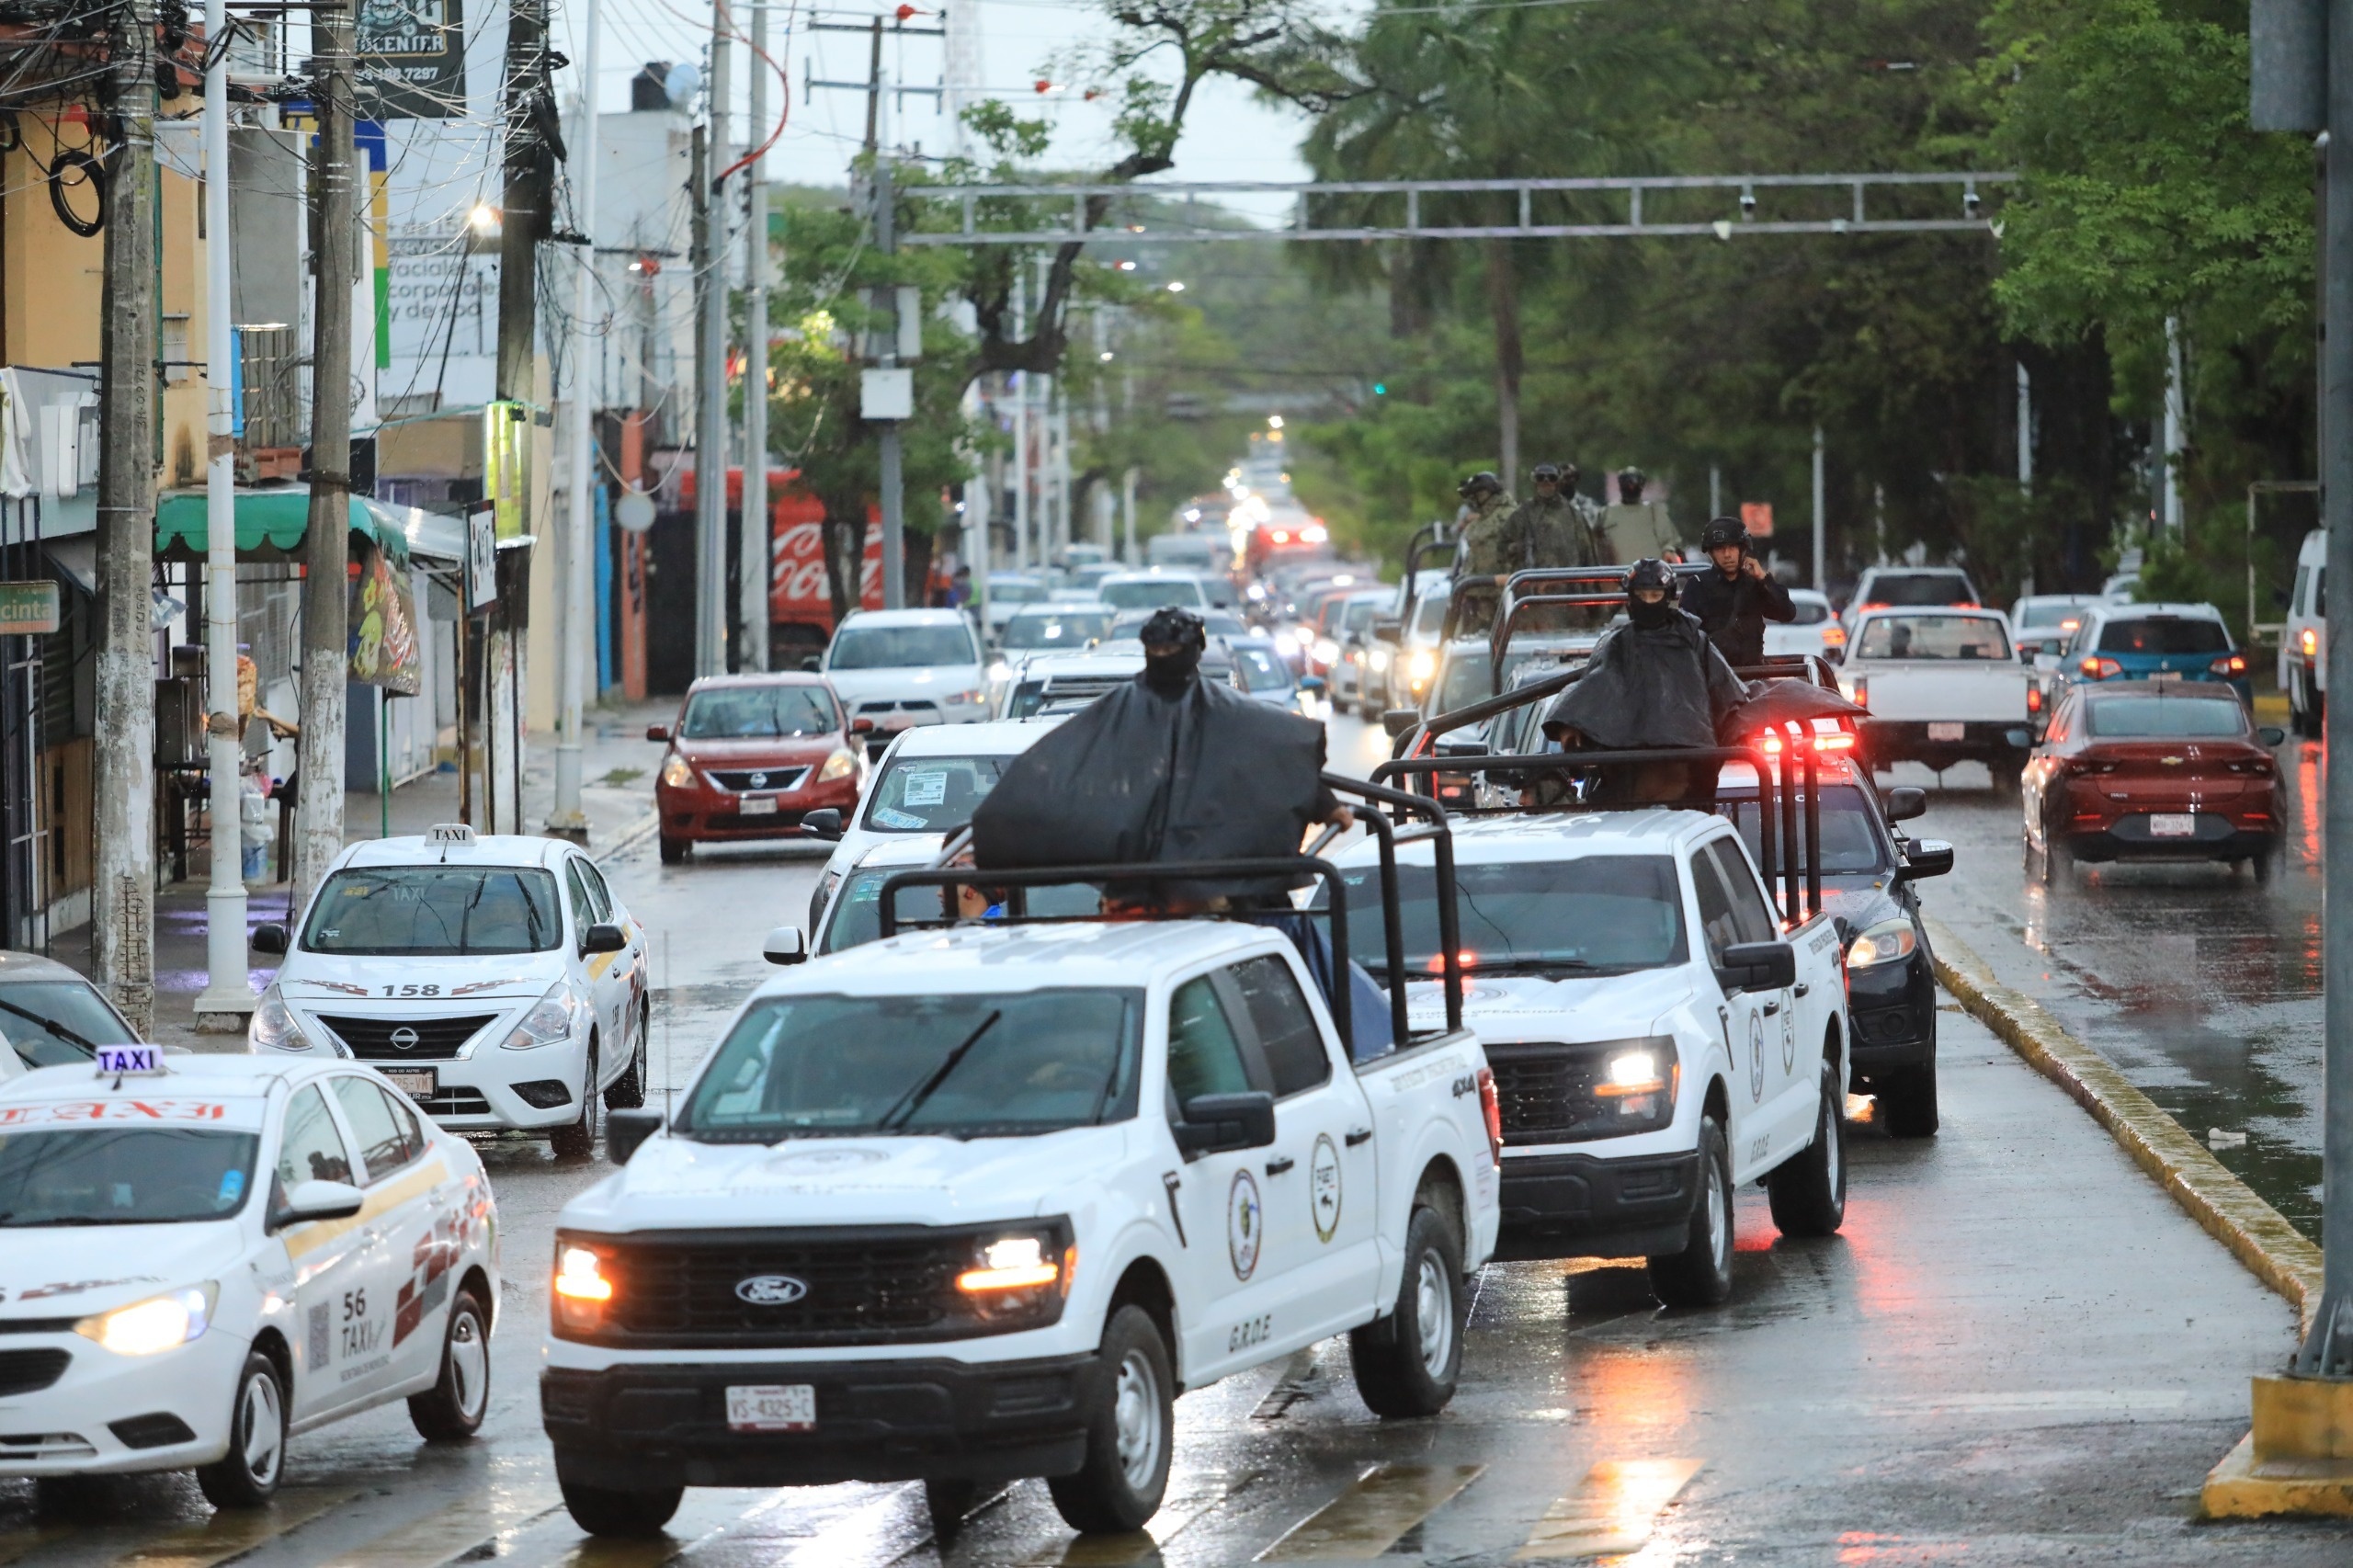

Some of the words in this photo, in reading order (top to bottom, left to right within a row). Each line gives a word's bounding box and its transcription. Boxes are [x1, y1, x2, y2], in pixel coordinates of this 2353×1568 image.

[404, 67, 439, 80] 7297
[406, 301, 433, 318] de
[433, 829, 467, 841] TAXI
[392, 886, 426, 902] TAXI
[382, 984, 440, 996] 158
[98, 1051, 154, 1071] TAXI
[344, 1288, 366, 1322] 56
[342, 1320, 372, 1358] TAXI
